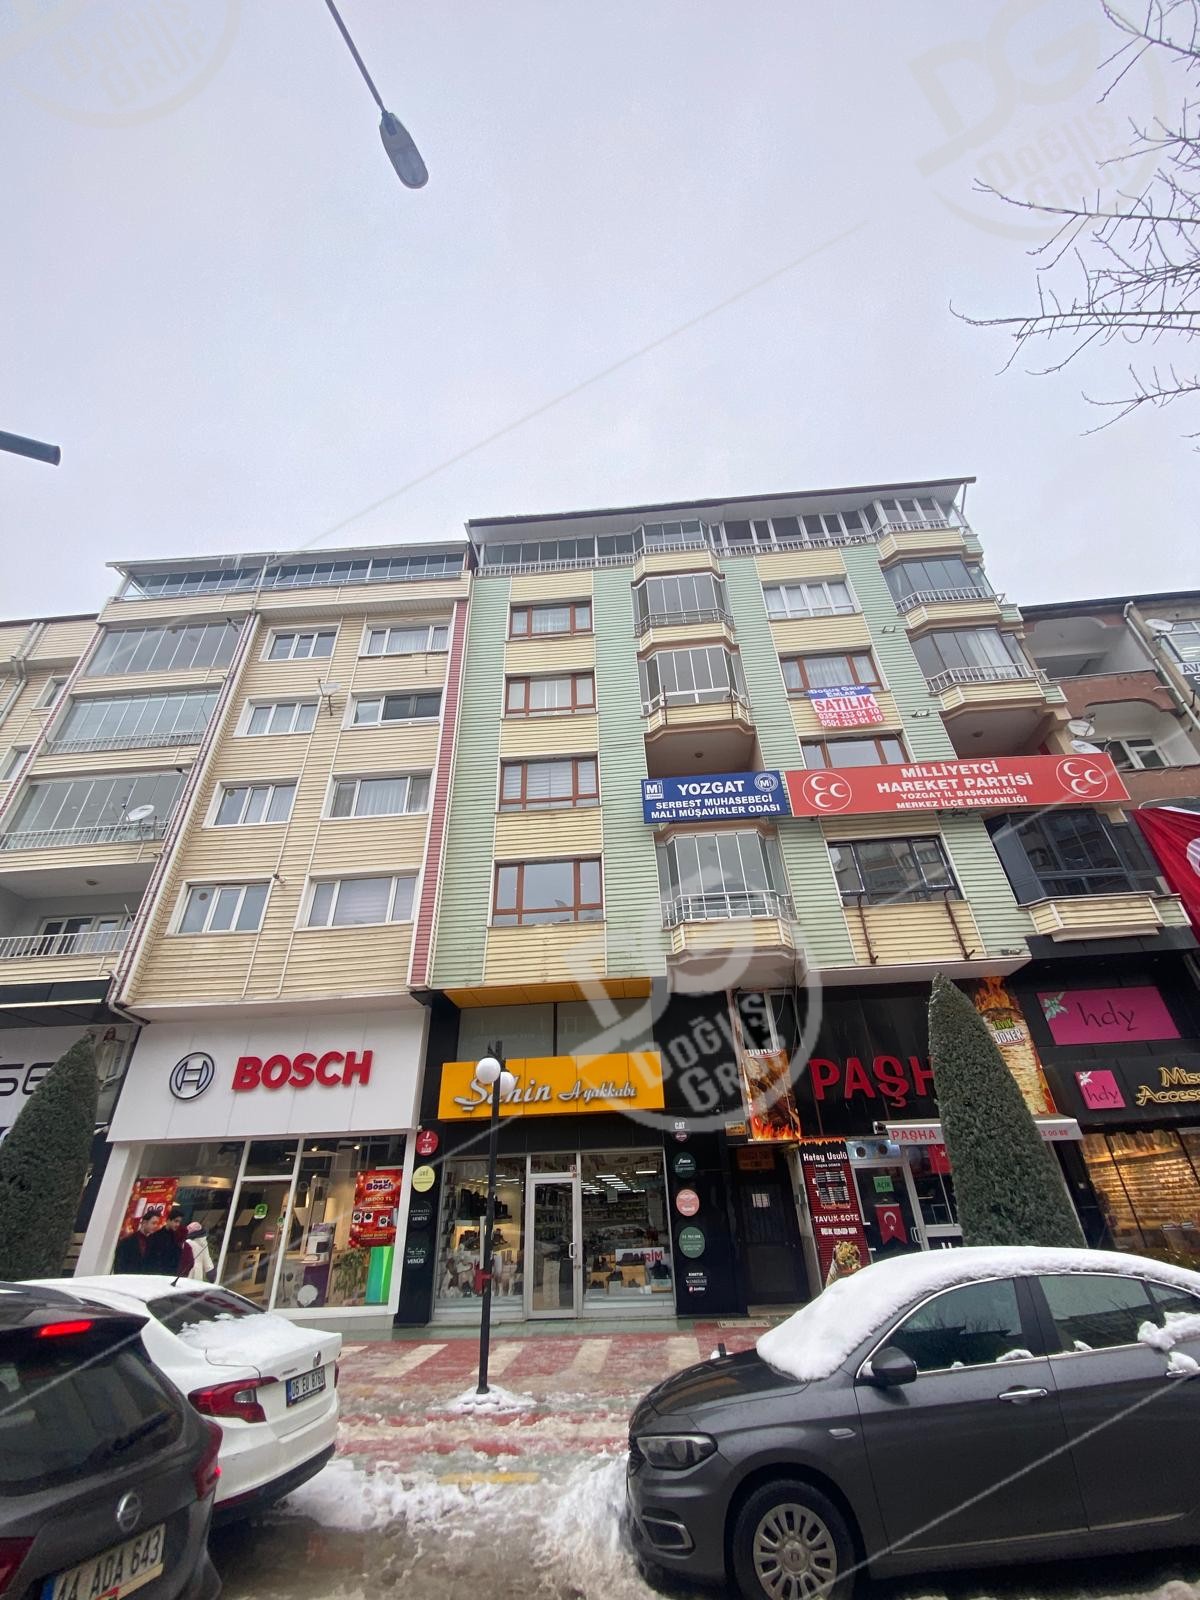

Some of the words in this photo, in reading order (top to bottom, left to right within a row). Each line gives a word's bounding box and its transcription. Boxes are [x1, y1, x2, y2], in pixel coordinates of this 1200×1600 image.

[815, 696, 876, 712] SATILIK
[900, 760, 1000, 778] MİLLİYETÇİ
[677, 780, 745, 796] YOZGAT
[876, 779, 959, 794] HAREKET
[963, 772, 1034, 789] PARTİSİ
[655, 799, 702, 810] SERBEST
[704, 793, 773, 807] MUHASEBECİ
[896, 801, 940, 809] MERKEZ
[941, 798, 965, 807] İLÇE
[966, 795, 1028, 806] BAŞKANLIĞI
[900, 791, 942, 800] YOZGAT
[944, 790, 955, 798] İL
[956, 786, 1018, 797] BAŞKANLIĞI
[651, 808, 677, 819] MALİ
[679, 806, 746, 819] MÜŞAVİRLER
[748, 803, 781, 813] ODASI
[1077, 1000, 1138, 1031] hdy
[231, 1050, 373, 1090] BOSCH
[808, 1055, 935, 1108] PAŞH
[454, 1075, 552, 1111] Şhin
[1084, 1085, 1118, 1104] hdy
[1136, 1085, 1200, 1106] Access
[803, 1153, 825, 1162] Hatay
[130, 1528, 161, 1575] 643
